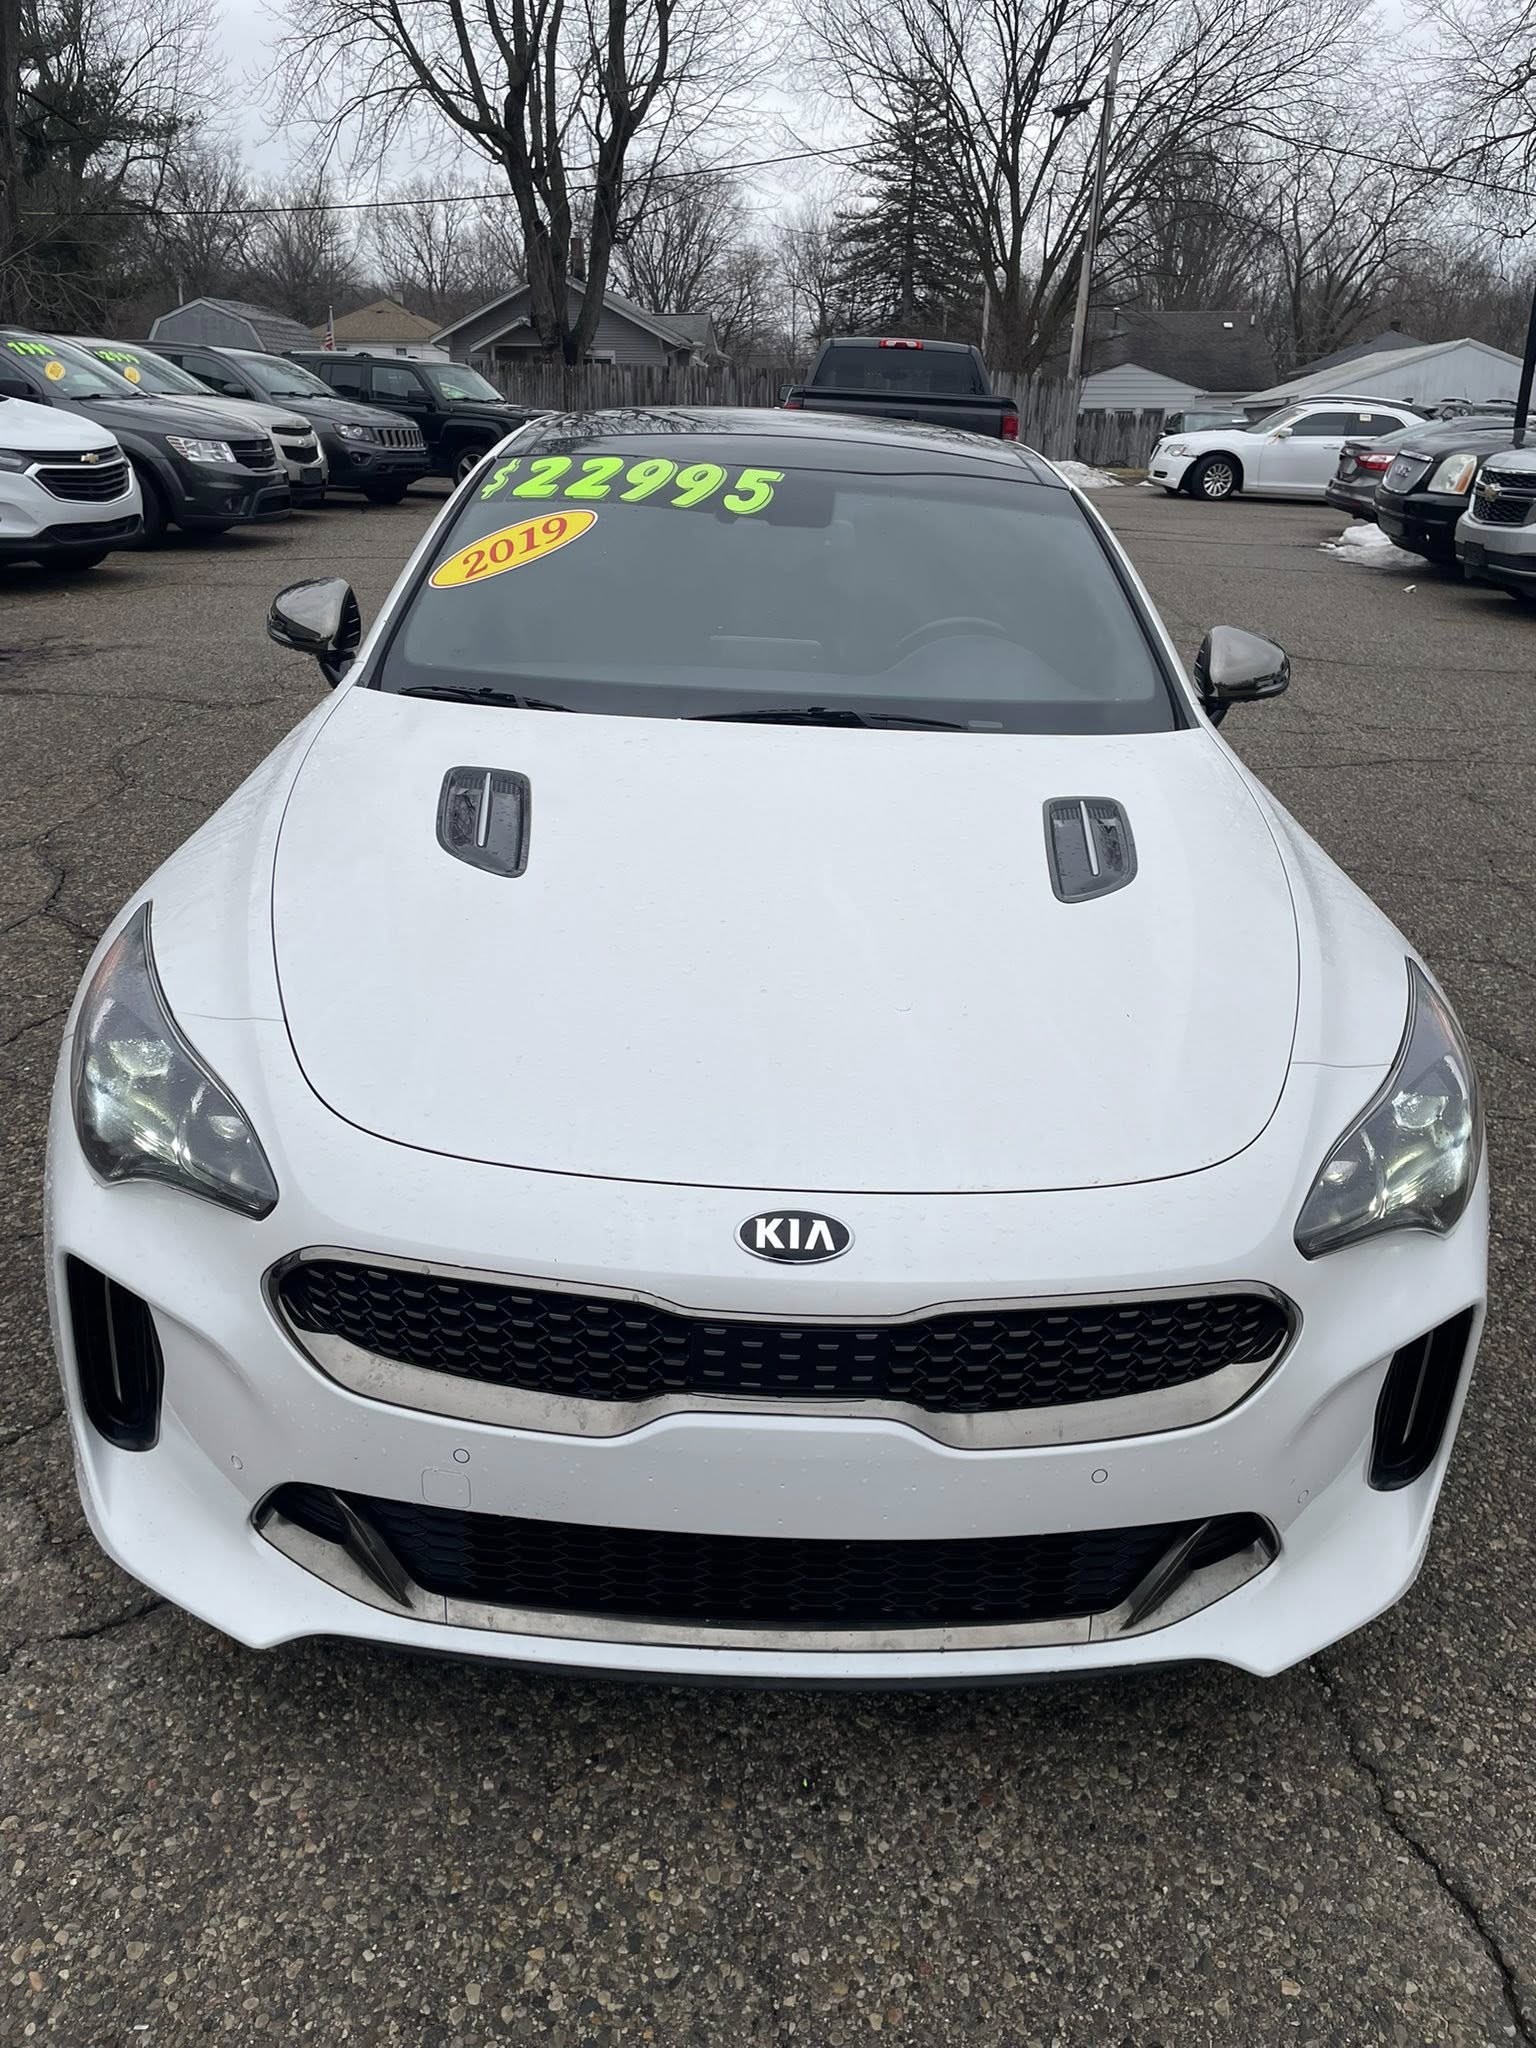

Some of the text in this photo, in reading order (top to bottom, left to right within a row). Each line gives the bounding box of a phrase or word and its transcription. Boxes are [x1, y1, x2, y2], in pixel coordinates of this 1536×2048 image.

[481, 456, 785, 515] $22995
[463, 517, 568, 579] 2019
[755, 1217, 836, 1251] KIA
